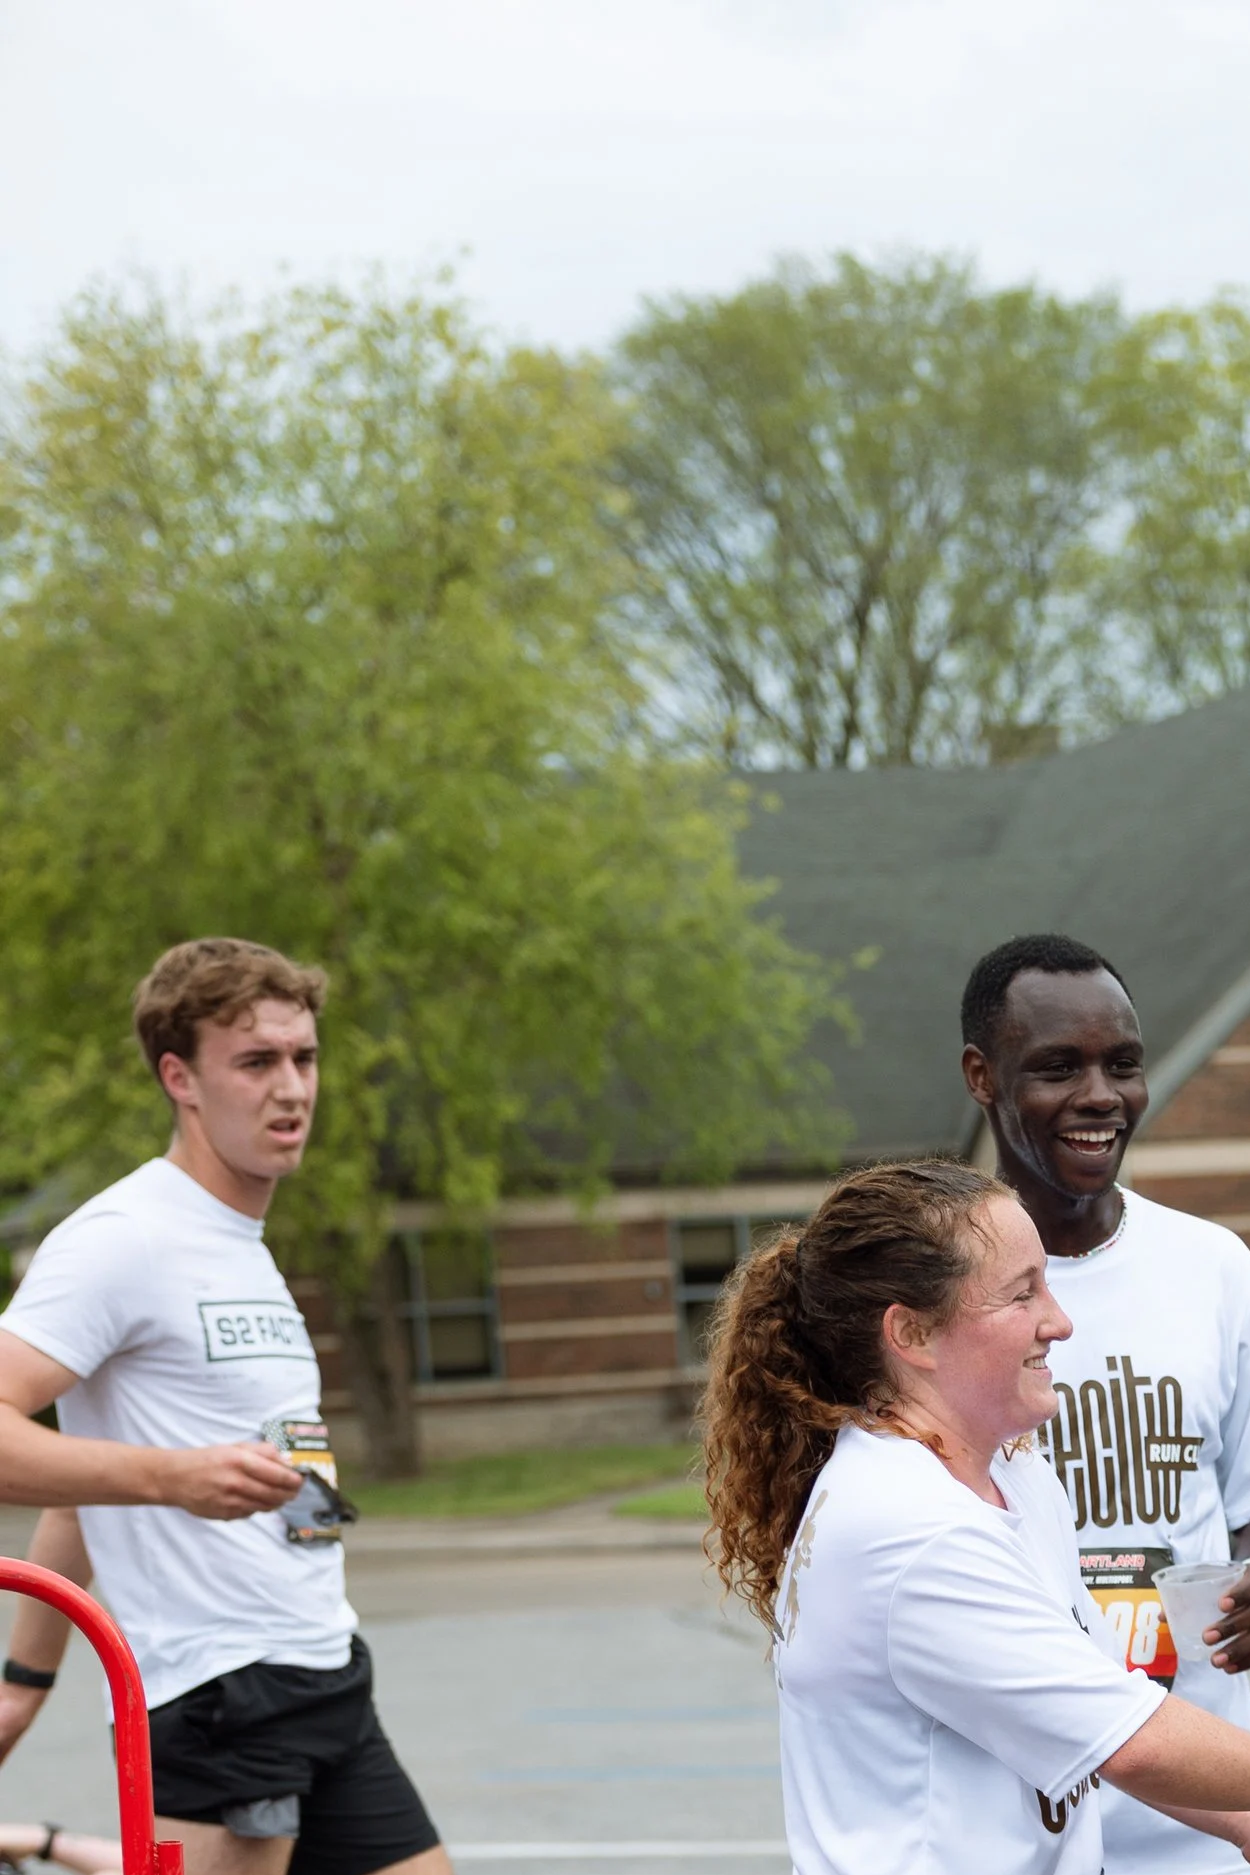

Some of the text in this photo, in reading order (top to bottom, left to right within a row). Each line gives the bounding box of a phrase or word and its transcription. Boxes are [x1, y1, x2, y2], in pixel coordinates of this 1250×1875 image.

[216, 1314, 256, 1346] S2
[1149, 1442, 1182, 1463] RUN
[1079, 1554, 1146, 1569] ARTLAND
